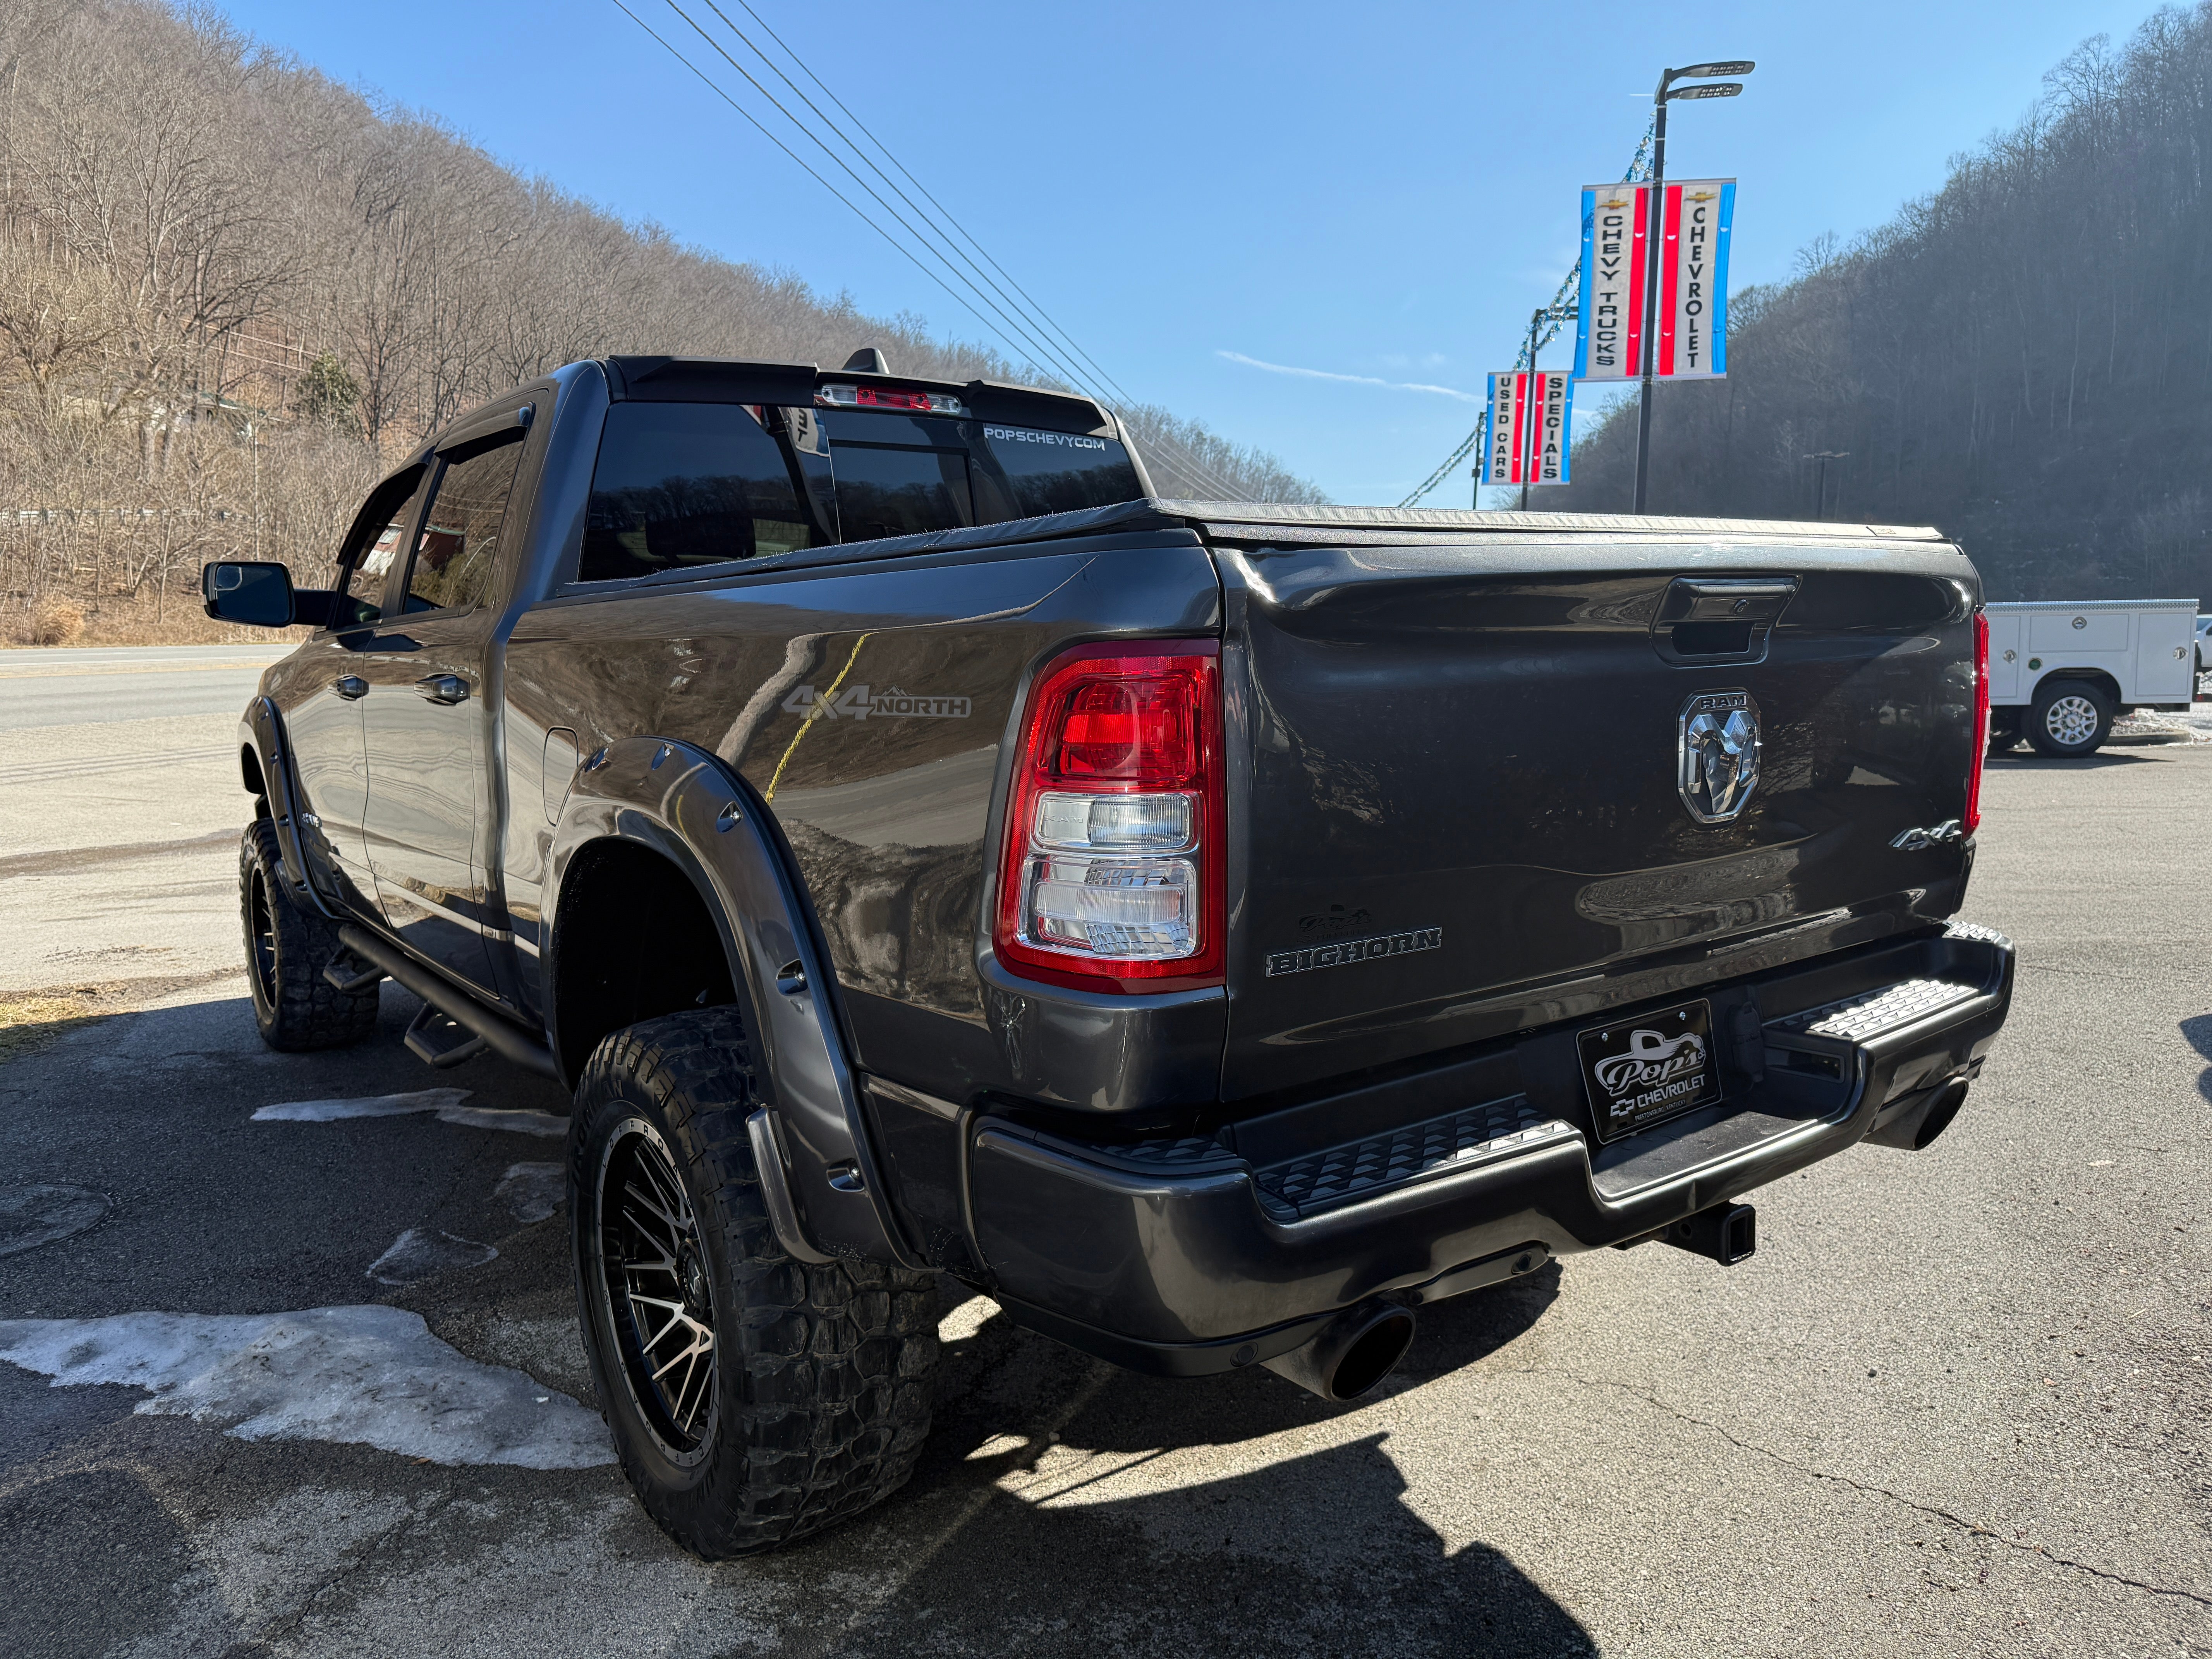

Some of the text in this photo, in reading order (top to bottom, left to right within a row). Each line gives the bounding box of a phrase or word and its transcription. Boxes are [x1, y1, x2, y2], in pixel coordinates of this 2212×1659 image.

[1596, 215, 1623, 366] CHEVY TRUCKS
[1685, 207, 1706, 368] CHEVROLET
[1495, 377, 1511, 477] USED CARS
[1543, 377, 1563, 479] SPECIALS
[876, 699, 967, 716] NORTH
[1700, 695, 1747, 709] RAM
[1044, 814, 1083, 823] RAM
[1266, 927, 1442, 977] BIGHORN
[1607, 1049, 1700, 1090] Pop's
[1637, 1074, 1705, 1108] CHEVROLET
